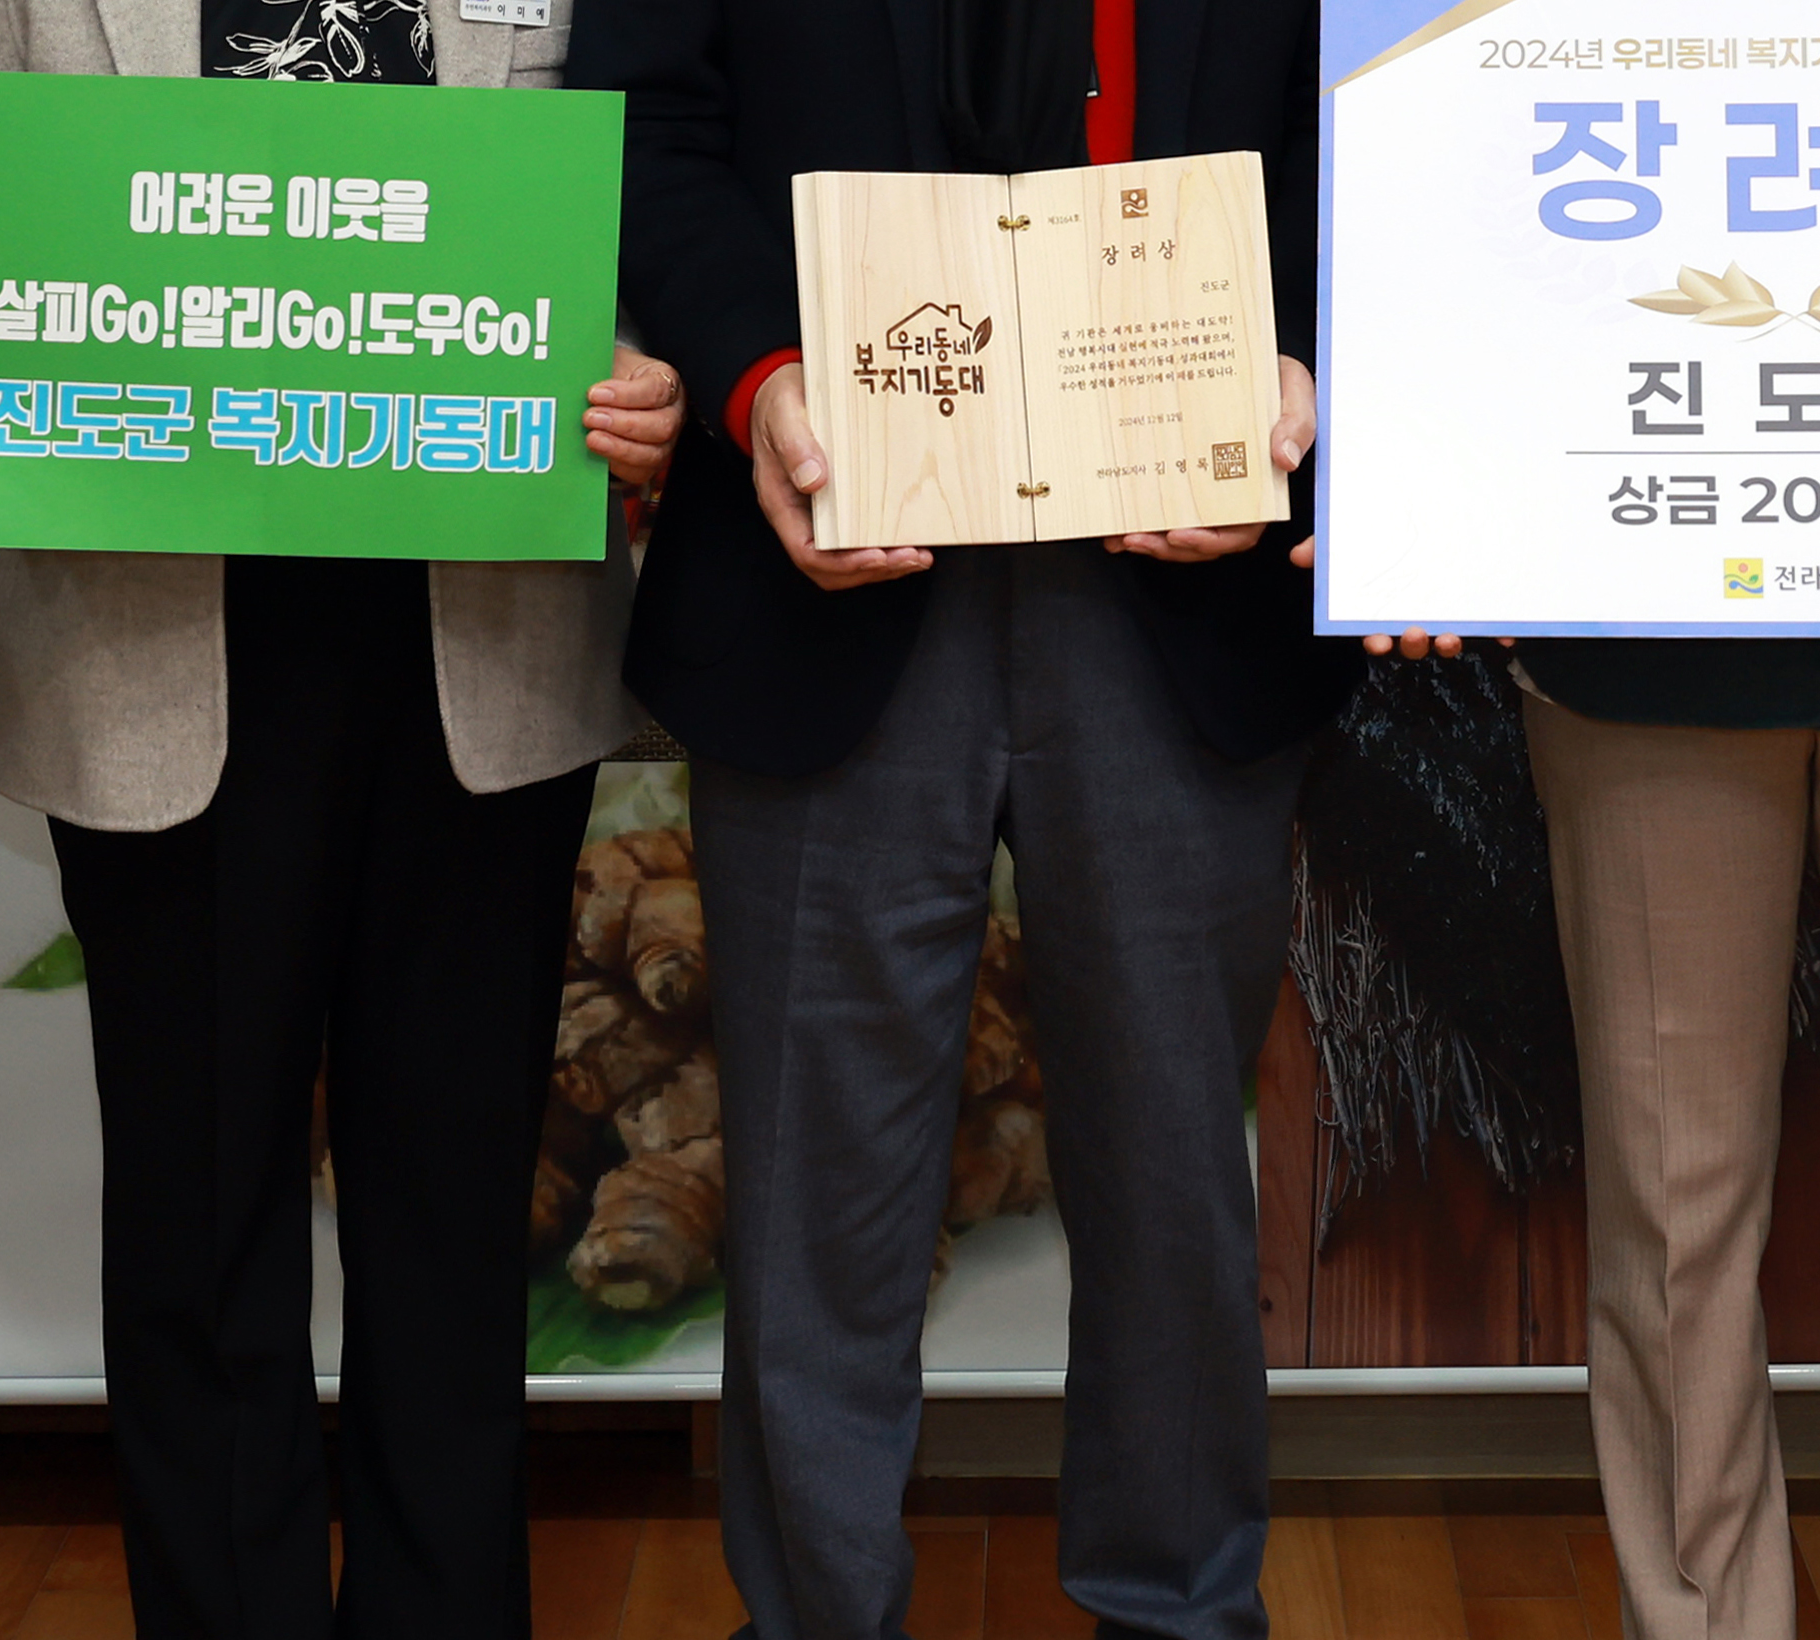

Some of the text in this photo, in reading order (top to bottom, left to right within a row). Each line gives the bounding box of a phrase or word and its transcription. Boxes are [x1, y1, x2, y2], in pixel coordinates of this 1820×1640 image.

[1479, 38, 1603, 70] 2024년
[1613, 37, 1737, 70] 우리동네
[130, 171, 430, 243] 어려운 이웃을
[1200, 279, 1230, 293] 진도군
[887, 328, 971, 363] 우리동네
[854, 343, 984, 417] 복지기동대
[208, 386, 557, 473] 복지기동대
[1096, 465, 1147, 479] 전라남도지사
[1608, 475, 1719, 526] 상금
